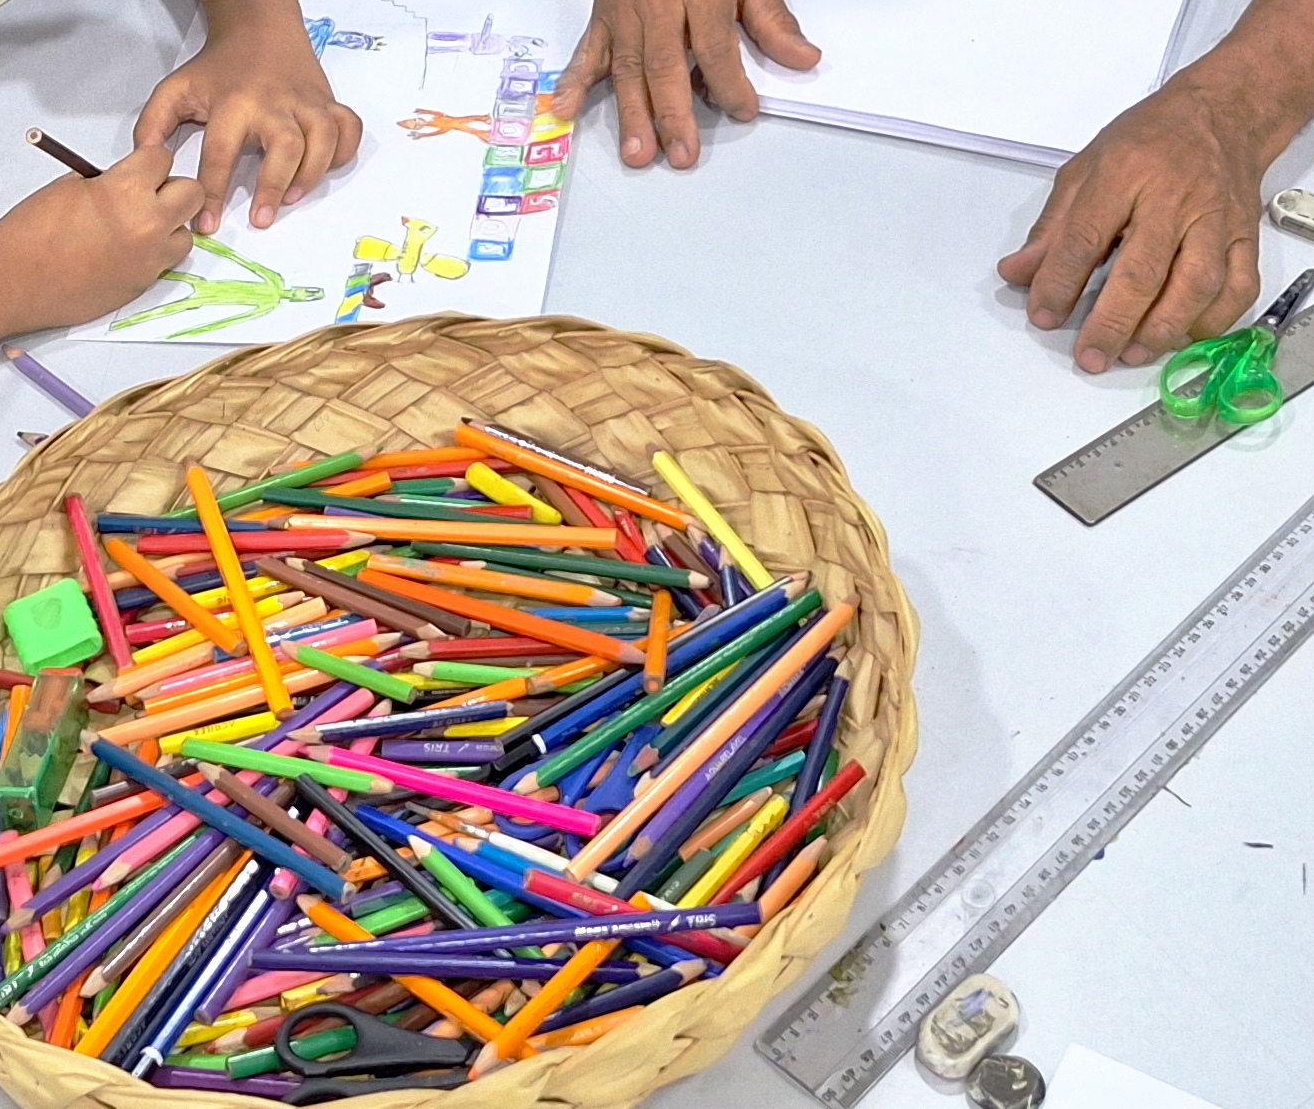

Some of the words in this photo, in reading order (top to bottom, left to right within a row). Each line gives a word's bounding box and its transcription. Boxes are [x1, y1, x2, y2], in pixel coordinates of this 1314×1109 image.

[522, 72, 568, 212] IGOS
[193, 720, 235, 735] ACRILEX
[423, 742, 450, 753] TRIS
